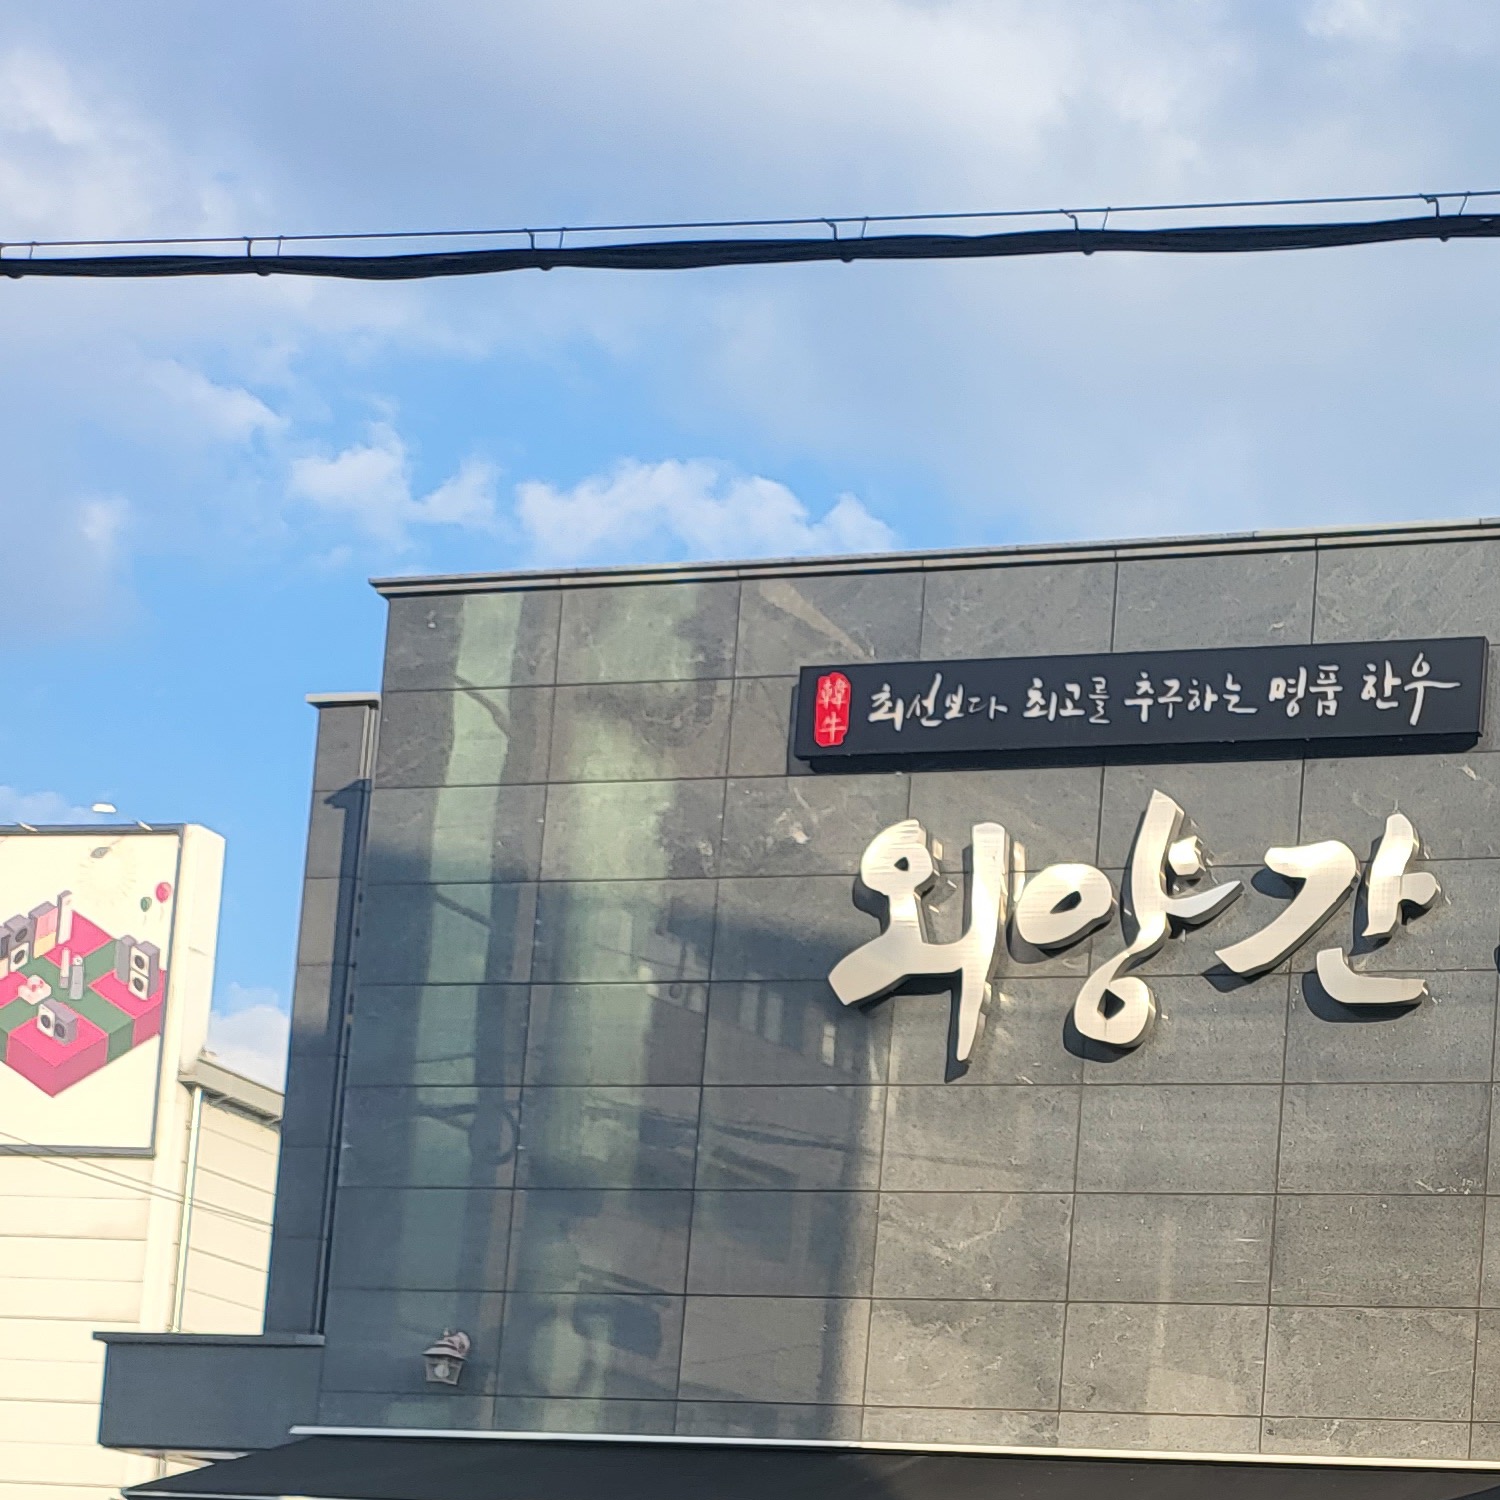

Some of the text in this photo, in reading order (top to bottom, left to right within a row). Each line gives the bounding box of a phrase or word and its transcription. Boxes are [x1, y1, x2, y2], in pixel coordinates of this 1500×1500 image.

[868, 652, 1461, 731] 최선보다 최고를 추구하는 명품 한우
[827, 788, 1441, 1064] 외양간
